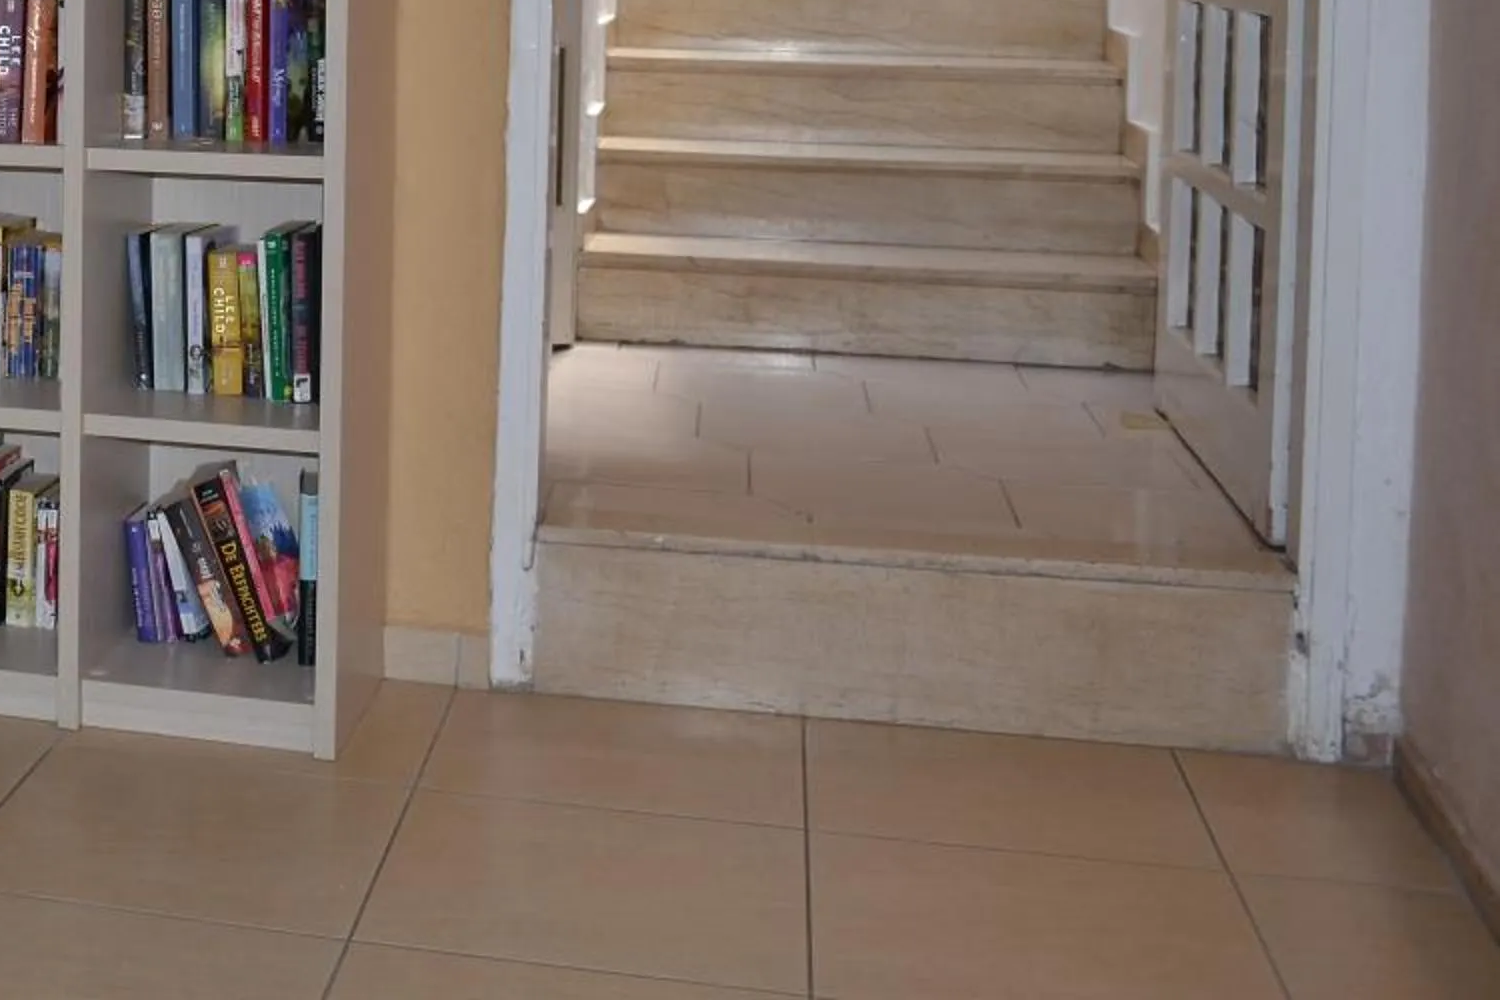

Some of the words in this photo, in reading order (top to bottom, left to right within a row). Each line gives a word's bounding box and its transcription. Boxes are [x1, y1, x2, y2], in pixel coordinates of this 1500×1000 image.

[11, 34, 21, 66] LEE
[212, 287, 225, 334] CHILD
[224, 295, 235, 324] LEE
[220, 541, 239, 564] DE
[230, 563, 268, 644] ERFPACHTERS
